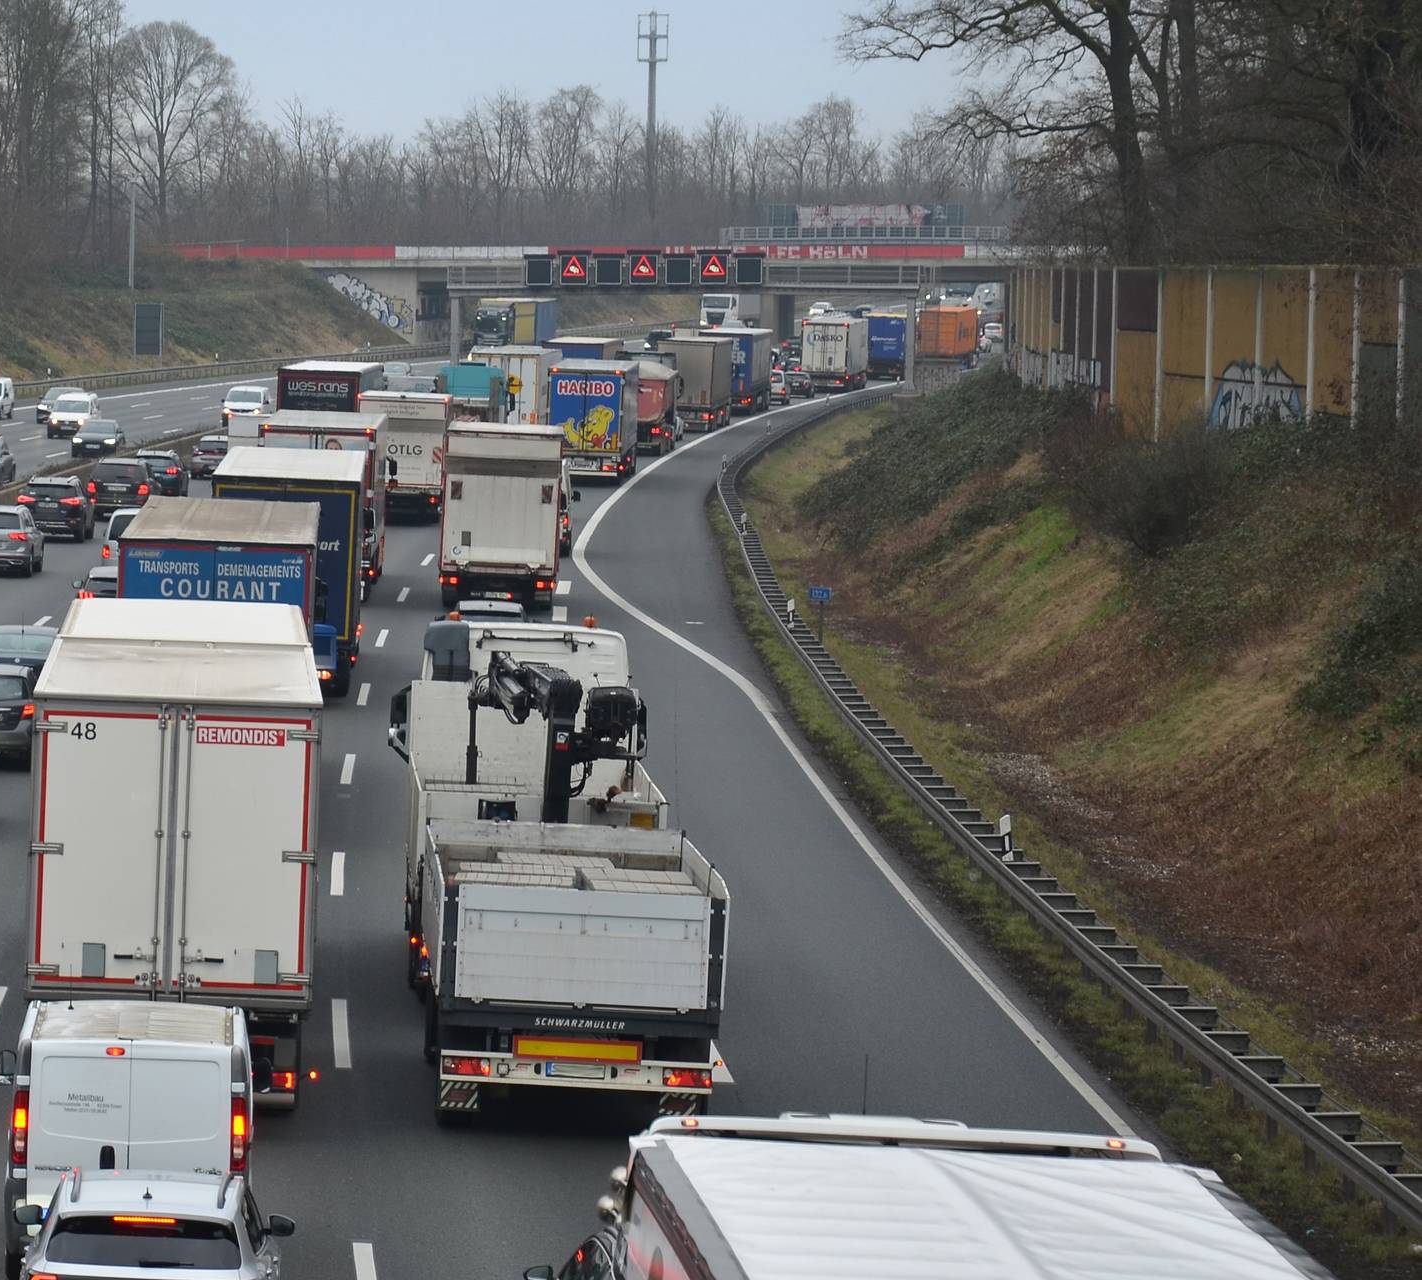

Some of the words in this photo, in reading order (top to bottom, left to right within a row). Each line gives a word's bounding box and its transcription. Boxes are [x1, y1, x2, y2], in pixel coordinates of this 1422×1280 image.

[558, 379, 615, 397] HARIBO
[387, 443, 423, 456] OTLG
[138, 559, 200, 576] TRANSPORTS
[216, 563, 302, 579] DEMENAGEMENTS
[159, 577, 281, 601] COURANT
[70, 721, 98, 741] 48
[197, 727, 279, 746] REMONDIS
